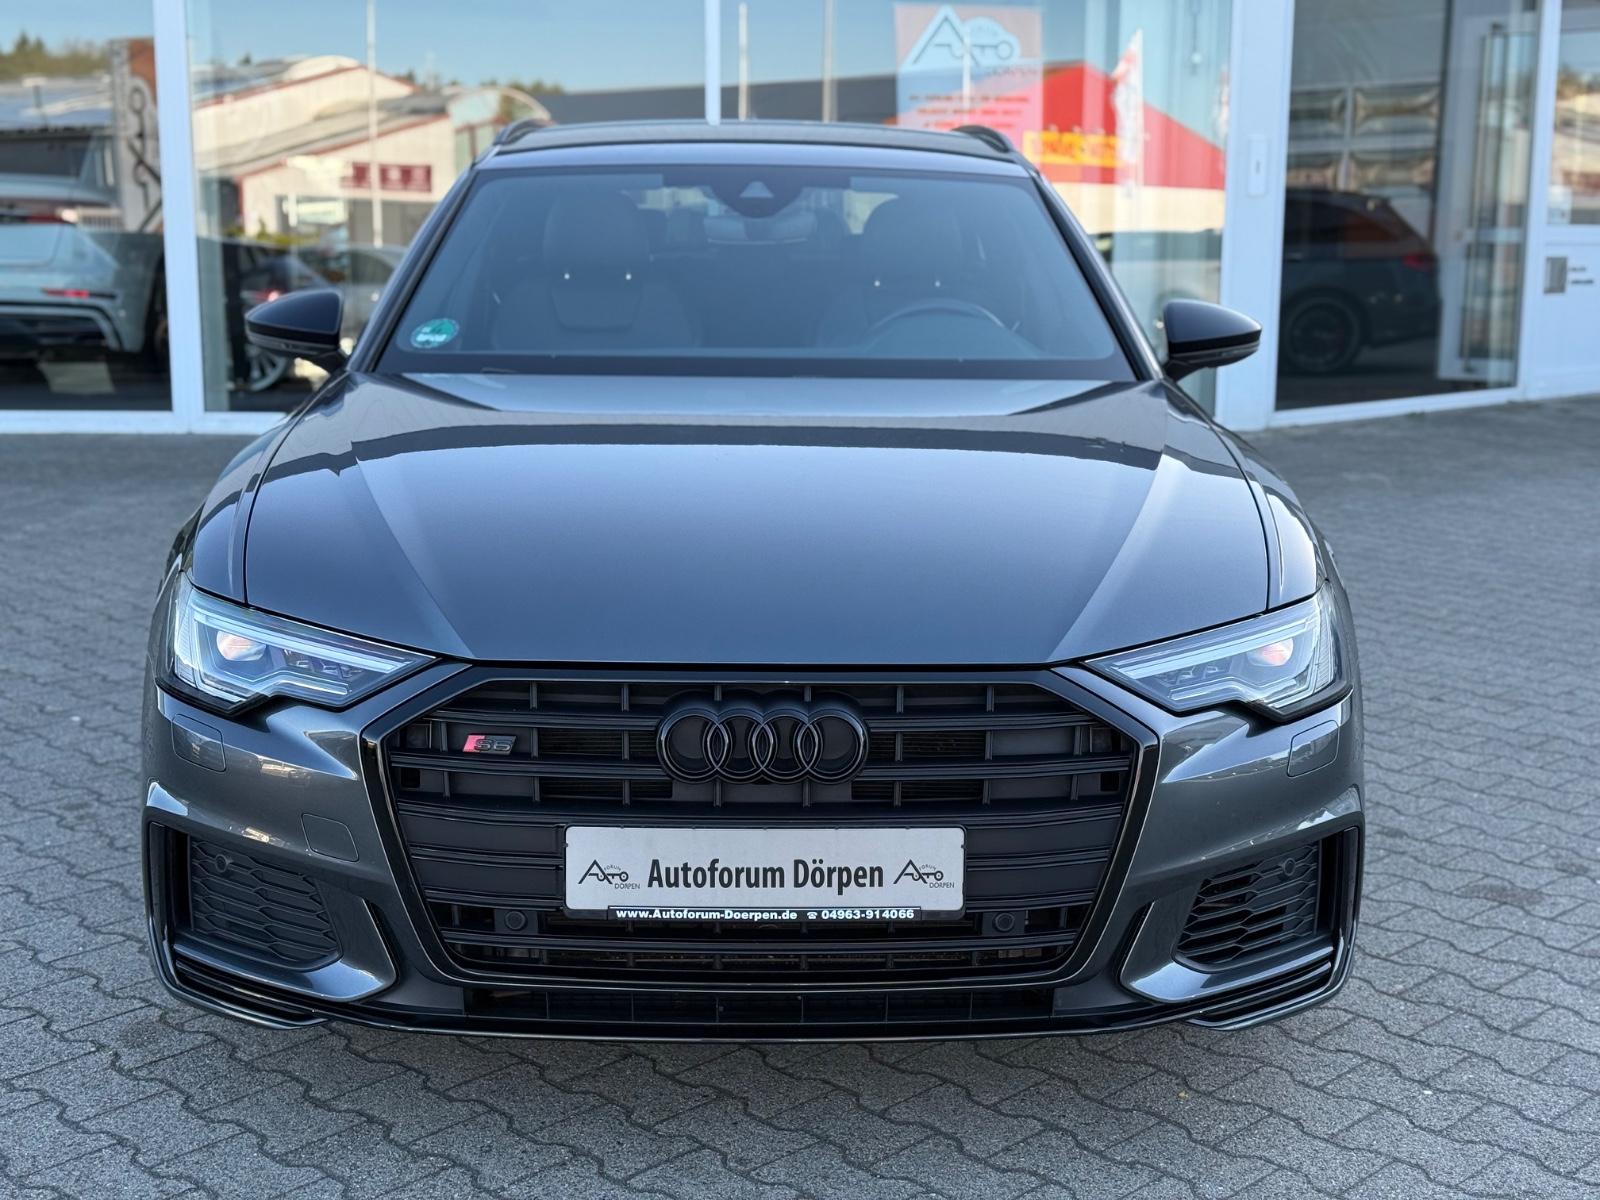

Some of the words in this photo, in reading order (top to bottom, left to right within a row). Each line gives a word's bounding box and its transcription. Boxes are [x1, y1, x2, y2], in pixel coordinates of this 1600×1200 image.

[647, 858, 785, 888] Autoforum
[793, 858, 884, 896] Dörpen
[616, 908, 798, 921] www.Autoforum-Doerpen.de
[821, 909, 915, 920] 04963-914066
